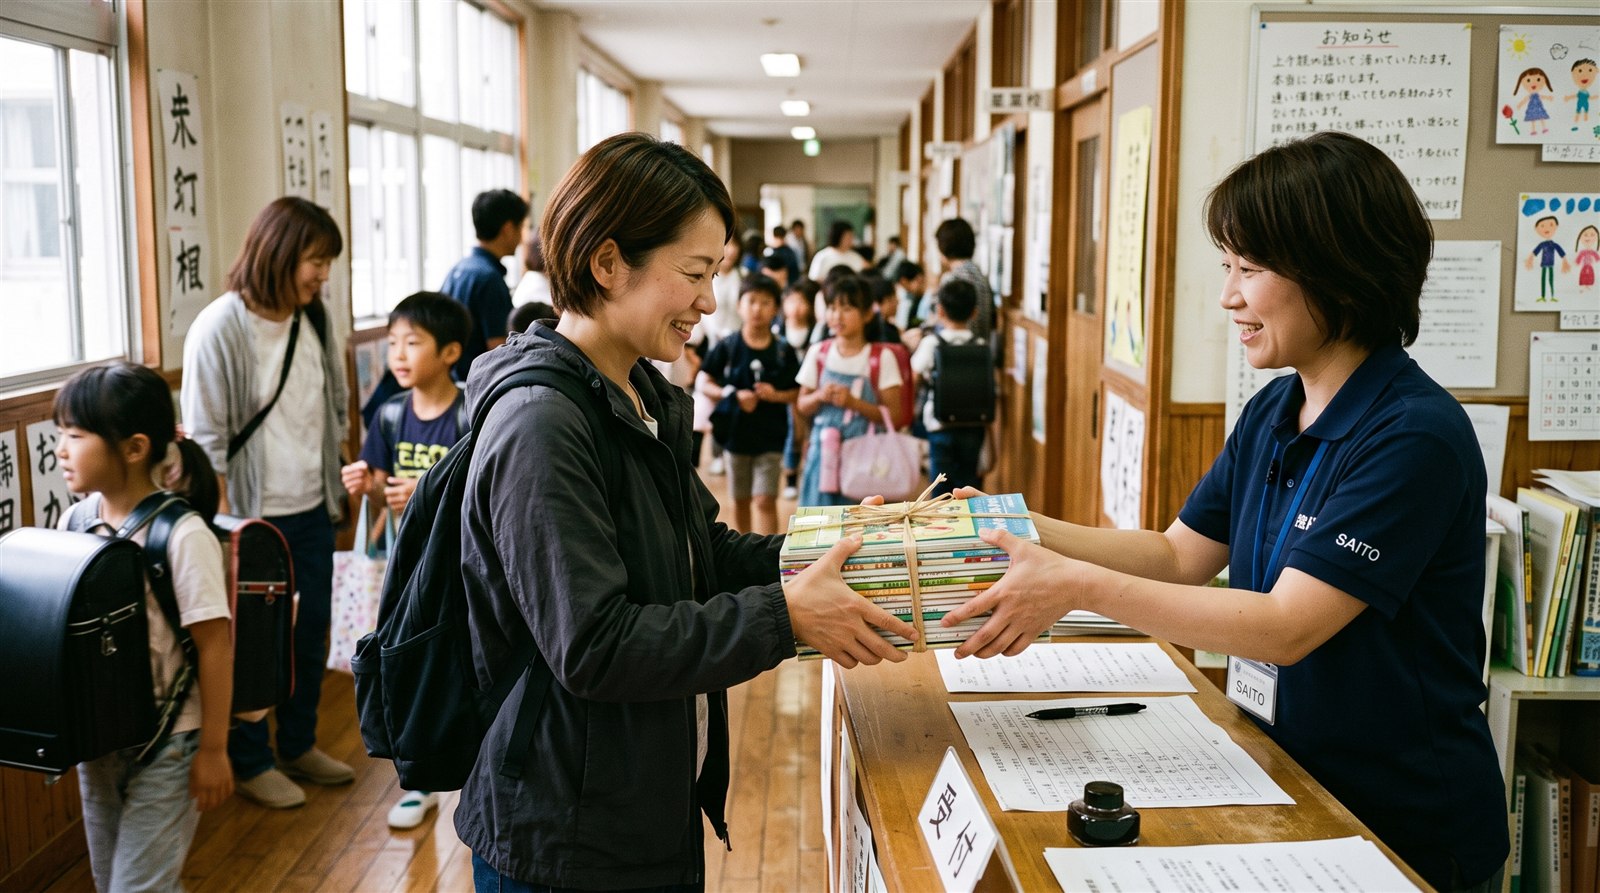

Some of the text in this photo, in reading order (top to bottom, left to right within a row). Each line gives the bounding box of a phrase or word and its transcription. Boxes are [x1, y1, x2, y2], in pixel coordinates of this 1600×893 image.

[1322, 29, 1392, 46] お知らせ
[1272, 75, 1307, 86] 本当に
[1585, 380, 1591, 388] 11
[1570, 406, 1578, 414] 24
[1335, 532, 1381, 562] SAITO
[1236, 679, 1265, 706] SAITO
[928, 782, 977, 879] 受付
